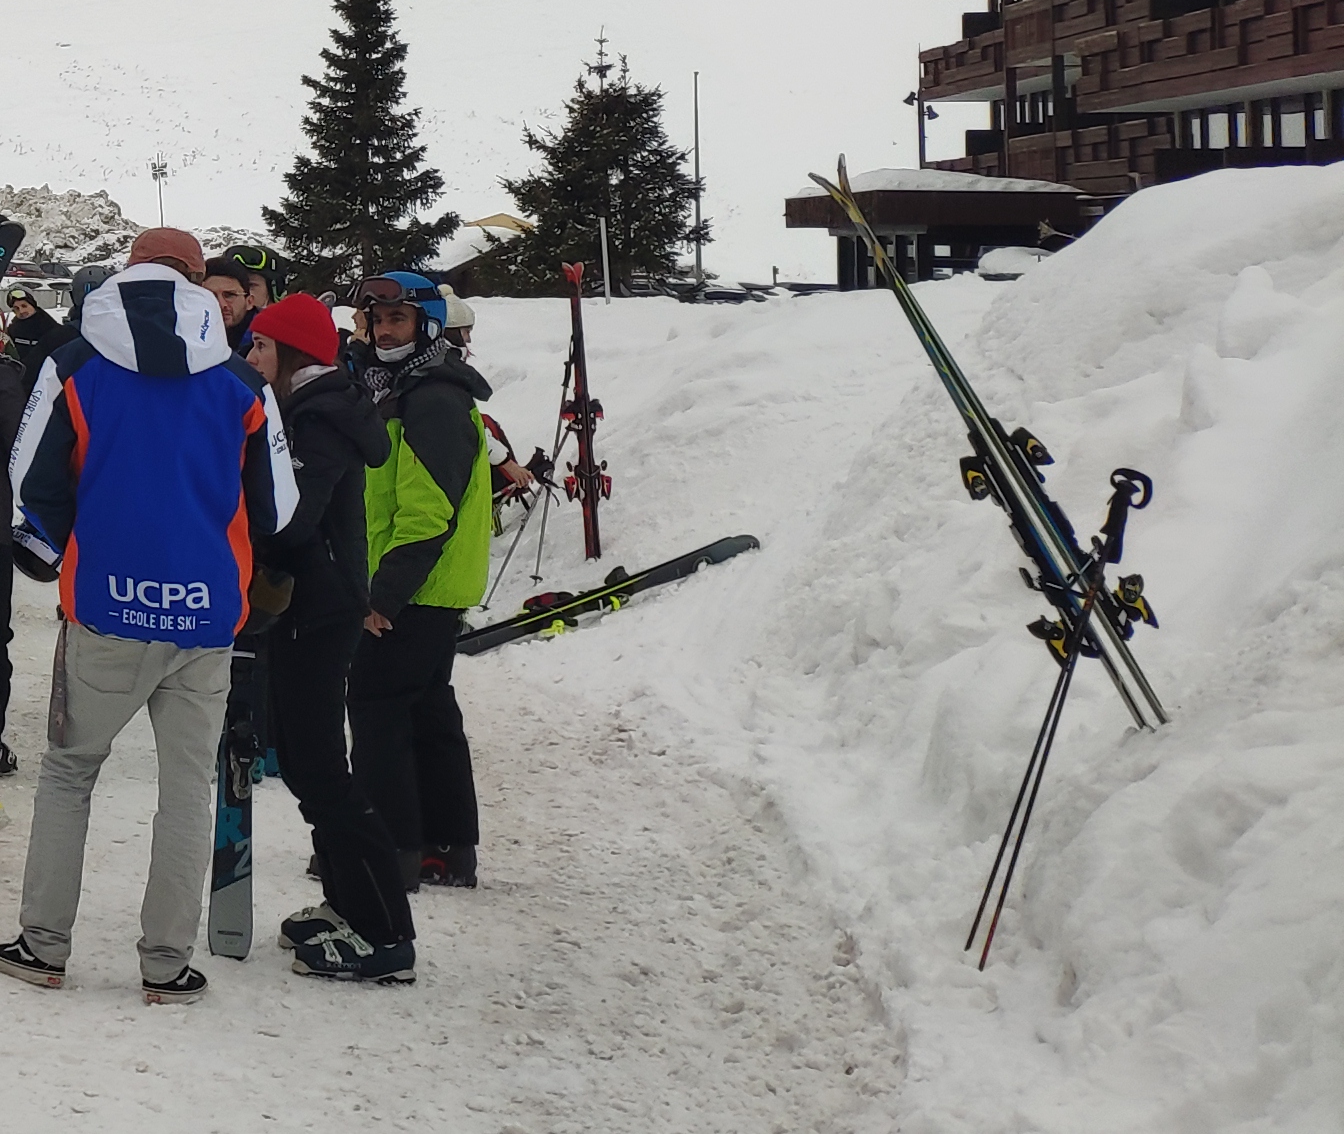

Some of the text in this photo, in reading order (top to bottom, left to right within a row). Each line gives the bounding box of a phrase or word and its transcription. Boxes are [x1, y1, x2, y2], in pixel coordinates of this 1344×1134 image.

[23, 389, 43, 421] SPORT
[14, 422, 29, 444] YOUR
[122, 608, 196, 631] ECOLE DE SKI
